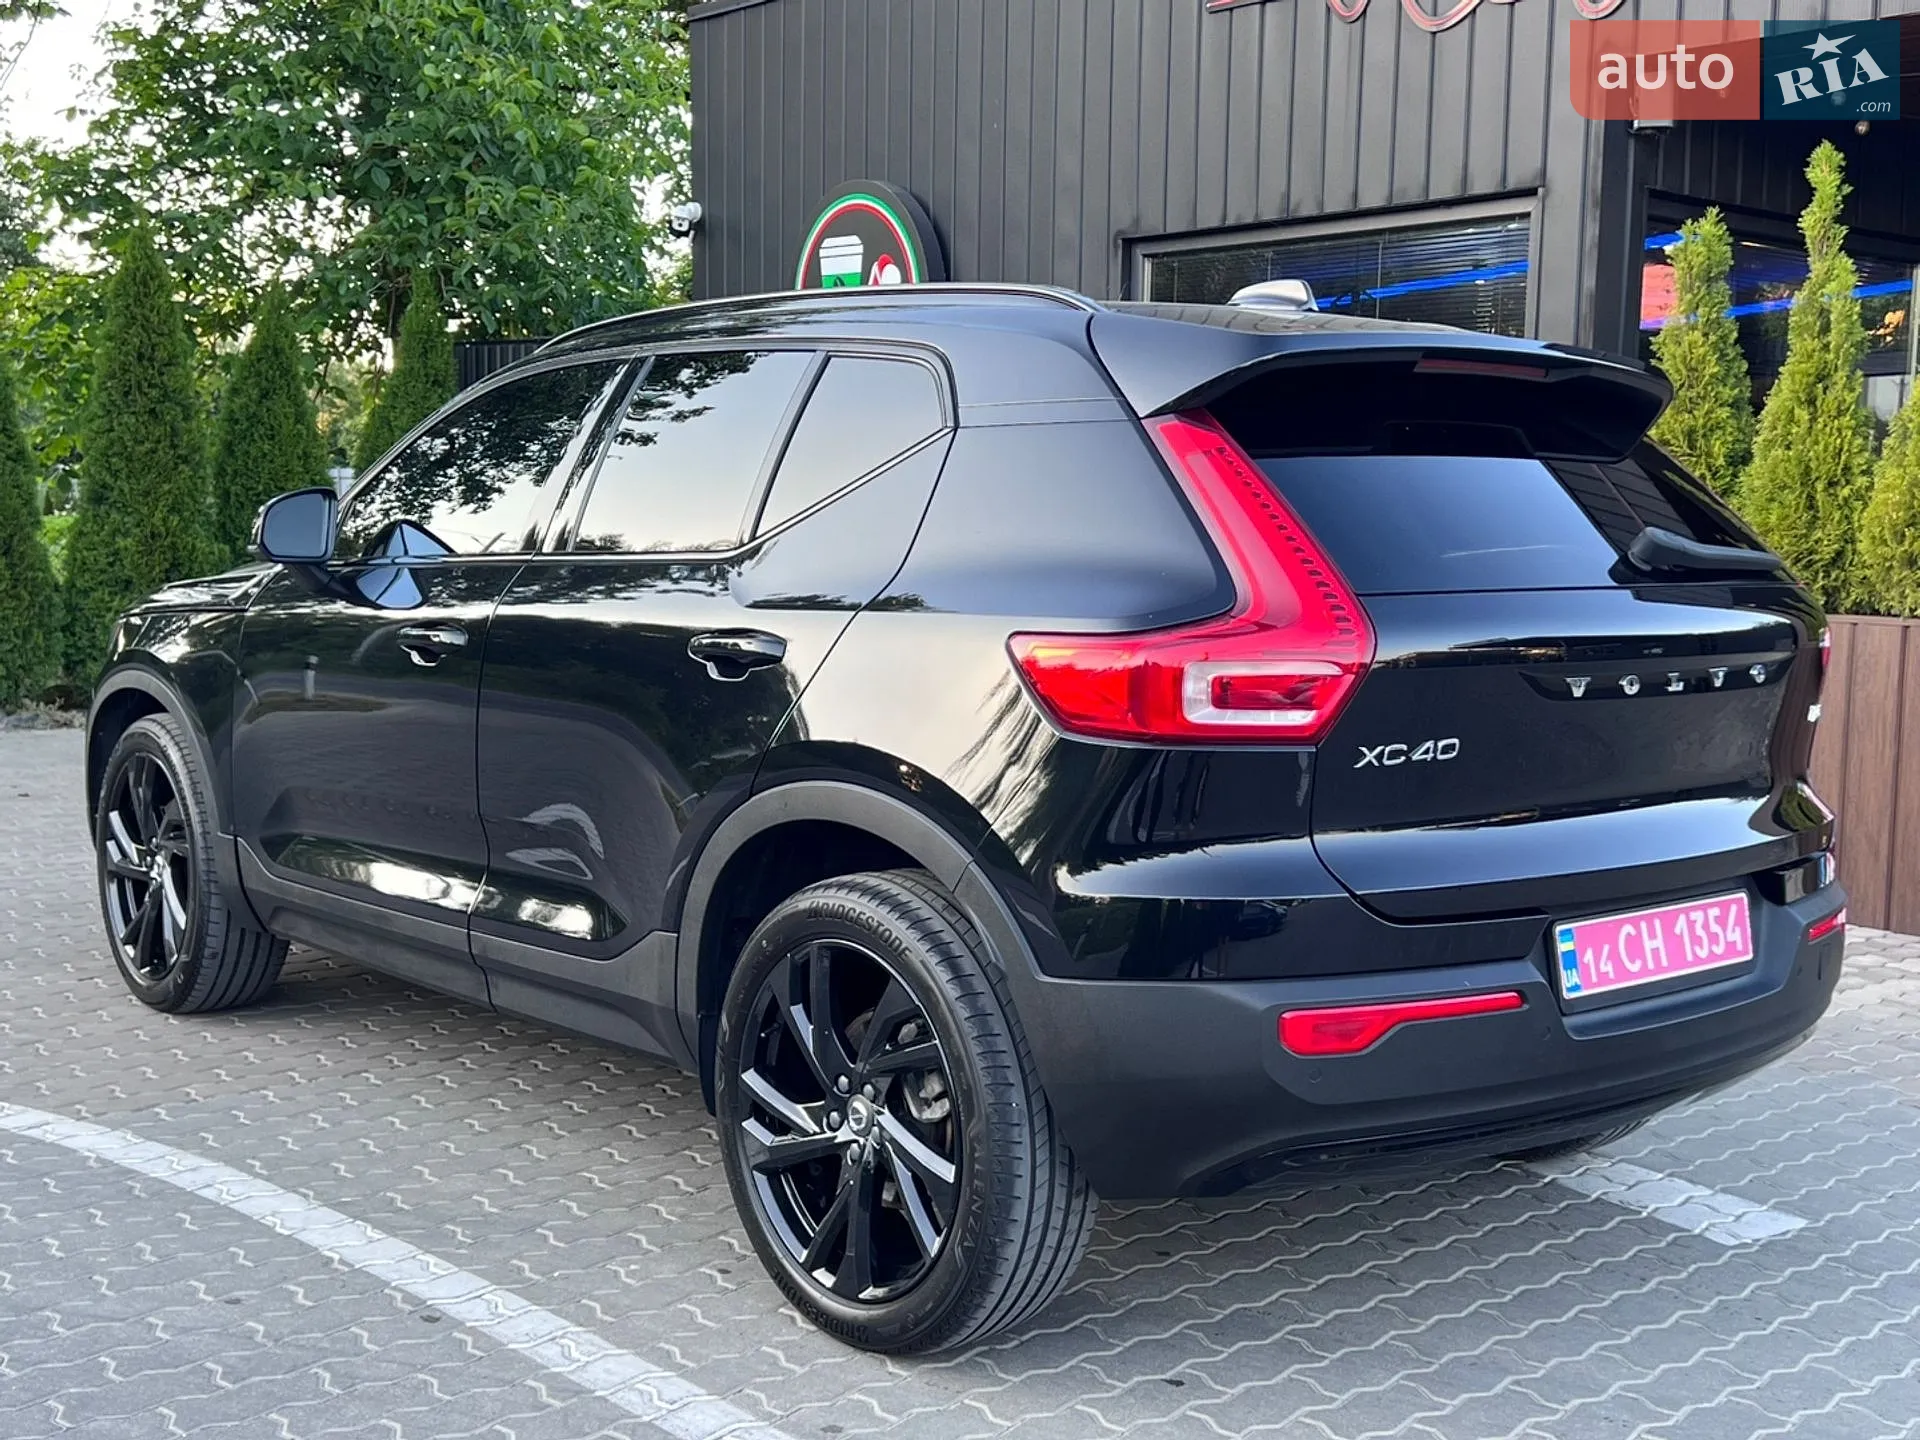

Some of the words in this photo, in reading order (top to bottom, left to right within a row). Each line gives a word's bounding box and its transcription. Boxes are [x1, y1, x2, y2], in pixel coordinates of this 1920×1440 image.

[1565, 664, 1767, 698] VOLVO
[1353, 738, 1459, 768] XC40
[1674, 903, 1743, 962] 1354
[1563, 969, 1580, 987] UA
